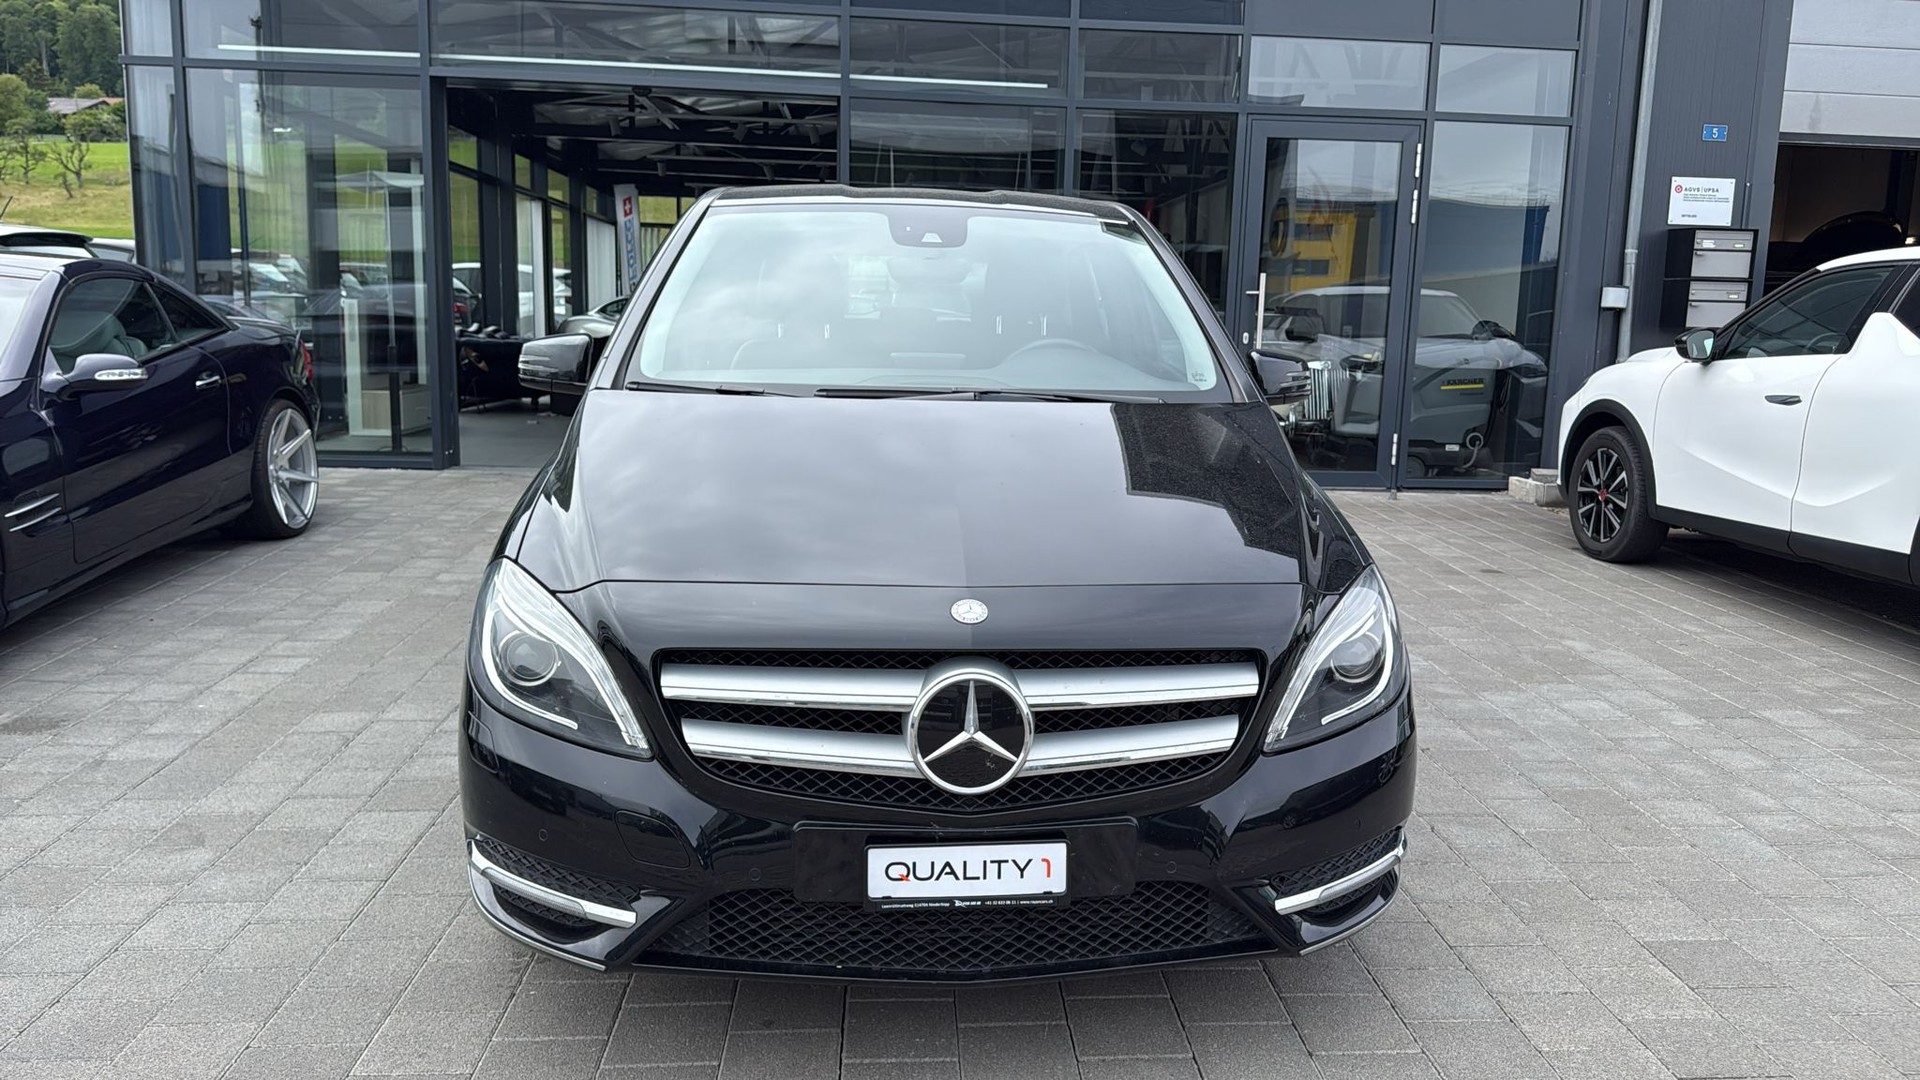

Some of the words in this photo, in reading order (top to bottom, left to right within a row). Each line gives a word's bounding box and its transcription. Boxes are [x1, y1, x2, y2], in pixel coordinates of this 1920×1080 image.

[1712, 127, 1719, 138] 5
[884, 859, 1033, 882] QUALITY
[1041, 858, 1051, 878] 1
